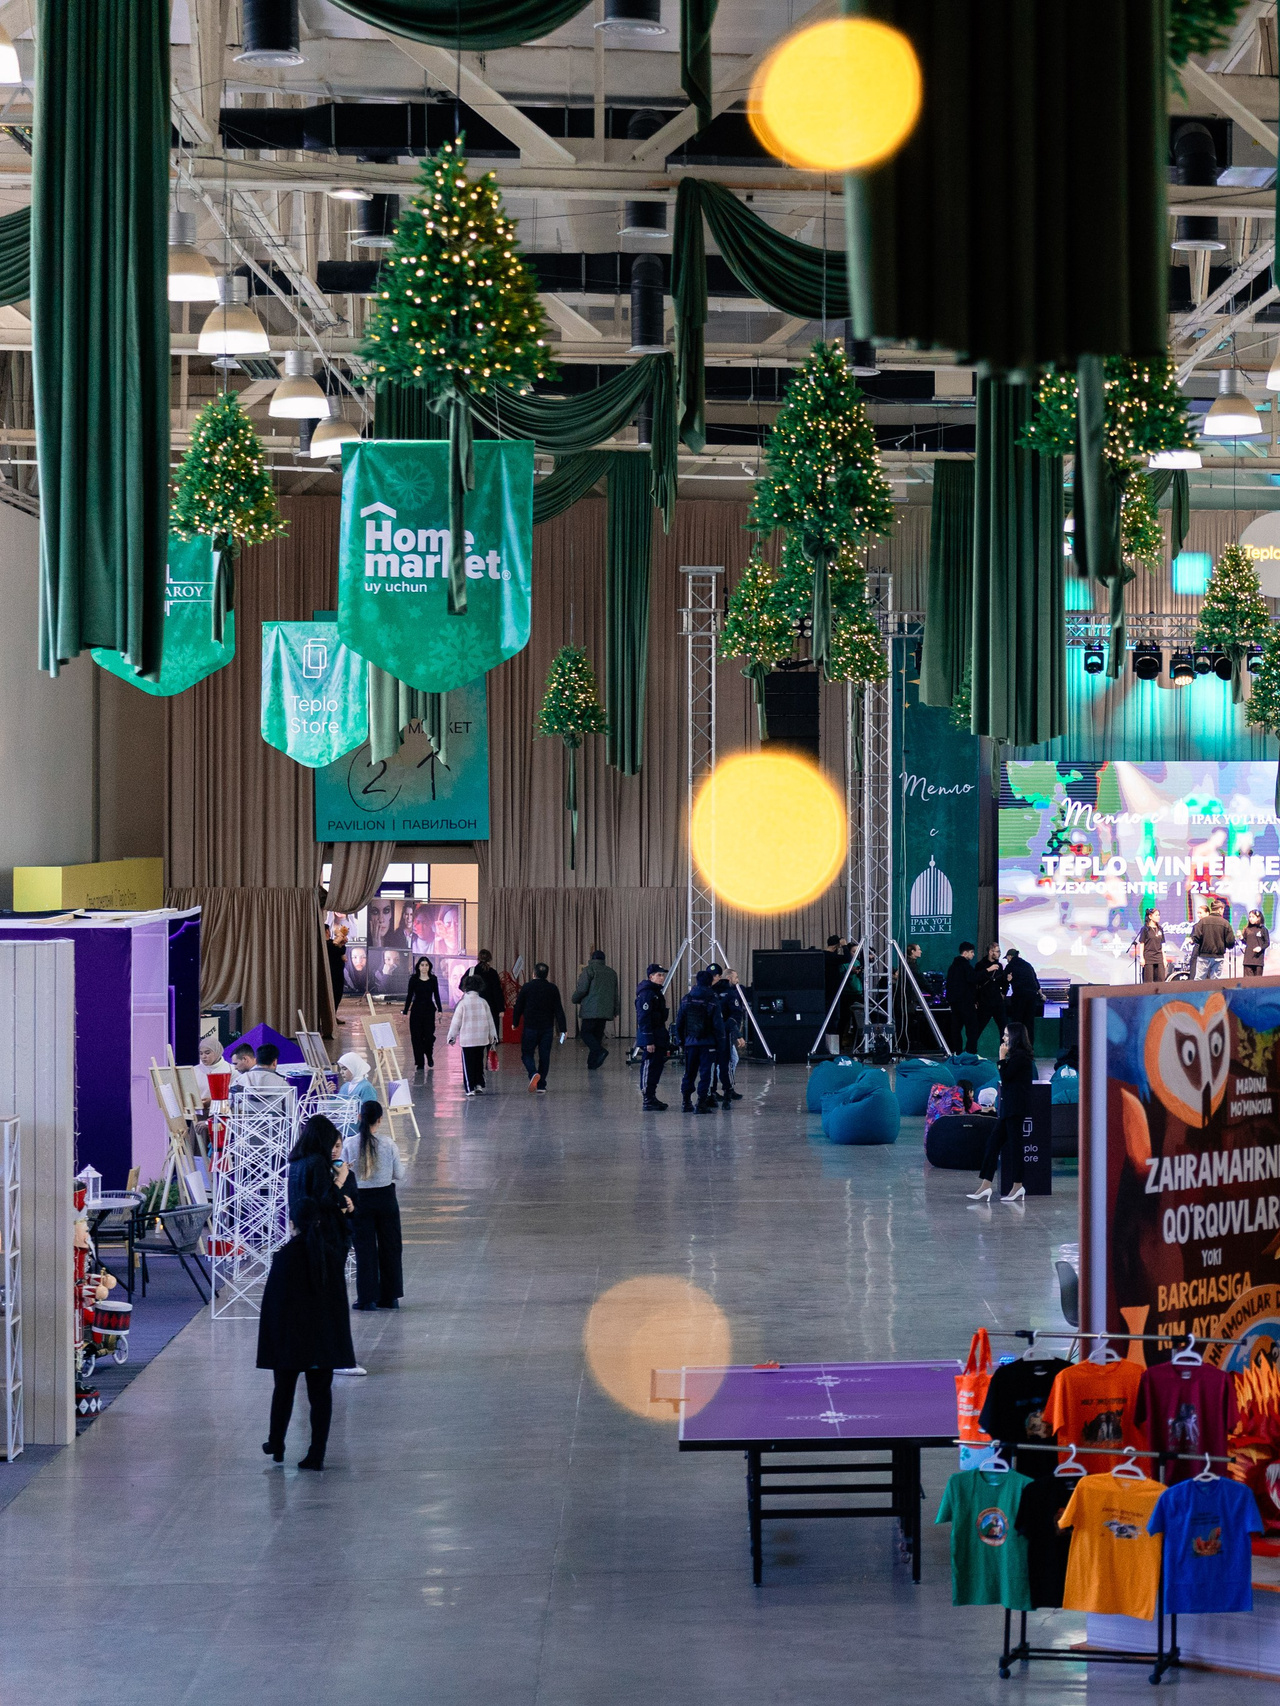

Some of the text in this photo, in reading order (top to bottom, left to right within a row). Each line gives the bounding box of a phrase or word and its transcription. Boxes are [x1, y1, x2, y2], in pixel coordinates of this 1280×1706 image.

[364, 549, 501, 580] maret
[364, 581, 428, 594] uy uchun
[290, 695, 339, 716] Teplo
[290, 717, 340, 734] Store
[361, 759, 388, 795] 2
[327, 819, 477, 831] PAVILION ПАВИЛЬОН
[1041, 855, 1128, 877] TEPLO
[910, 918, 930, 926] IPAK
[910, 925, 952, 933] BANKI
[1235, 1076, 1268, 1096] MADINA
[1201, 1247, 1222, 1268] YOKI
[1157, 1271, 1253, 1313] BARCHASIGA
